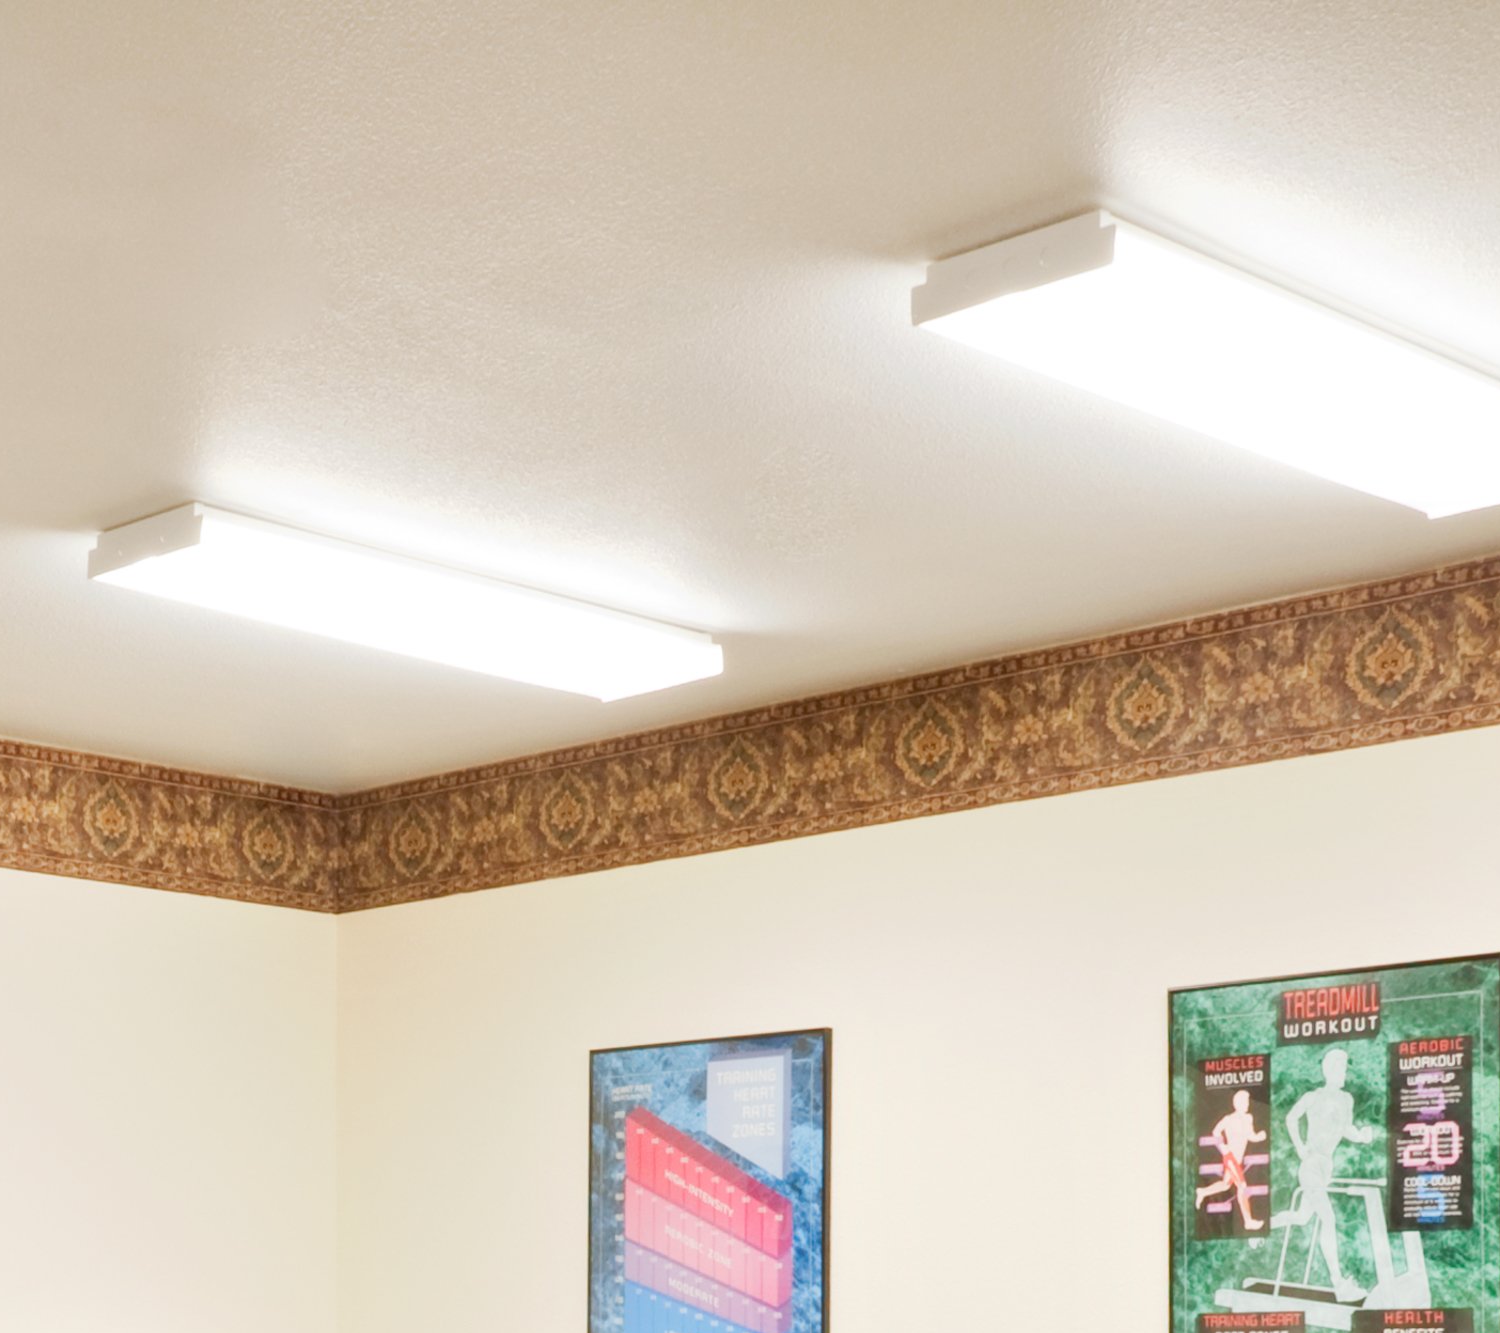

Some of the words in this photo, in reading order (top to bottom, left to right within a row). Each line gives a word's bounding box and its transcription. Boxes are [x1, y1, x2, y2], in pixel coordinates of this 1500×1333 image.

[1283, 983, 1380, 1020] TREADMILL
[1284, 1015, 1378, 1039] WORKOUT
[1399, 1037, 1465, 1054] AEROBIC
[1204, 1056, 1264, 1073] MUSCLES
[1399, 1053, 1465, 1071] WORKOUT
[717, 1068, 777, 1085] TRAINING
[1204, 1070, 1264, 1087] INVOLVED
[733, 1085, 776, 1102] HEART
[742, 1103, 776, 1119] RATE
[732, 1122, 776, 1138] ZONES
[1403, 1120, 1461, 1168] 20
[664, 1168, 735, 1217] HIGH-INTENSITY
[1203, 1313, 1258, 1328] TRAINING
[1260, 1313, 1302, 1327] HEART
[1384, 1311, 1445, 1325] HEALTH
